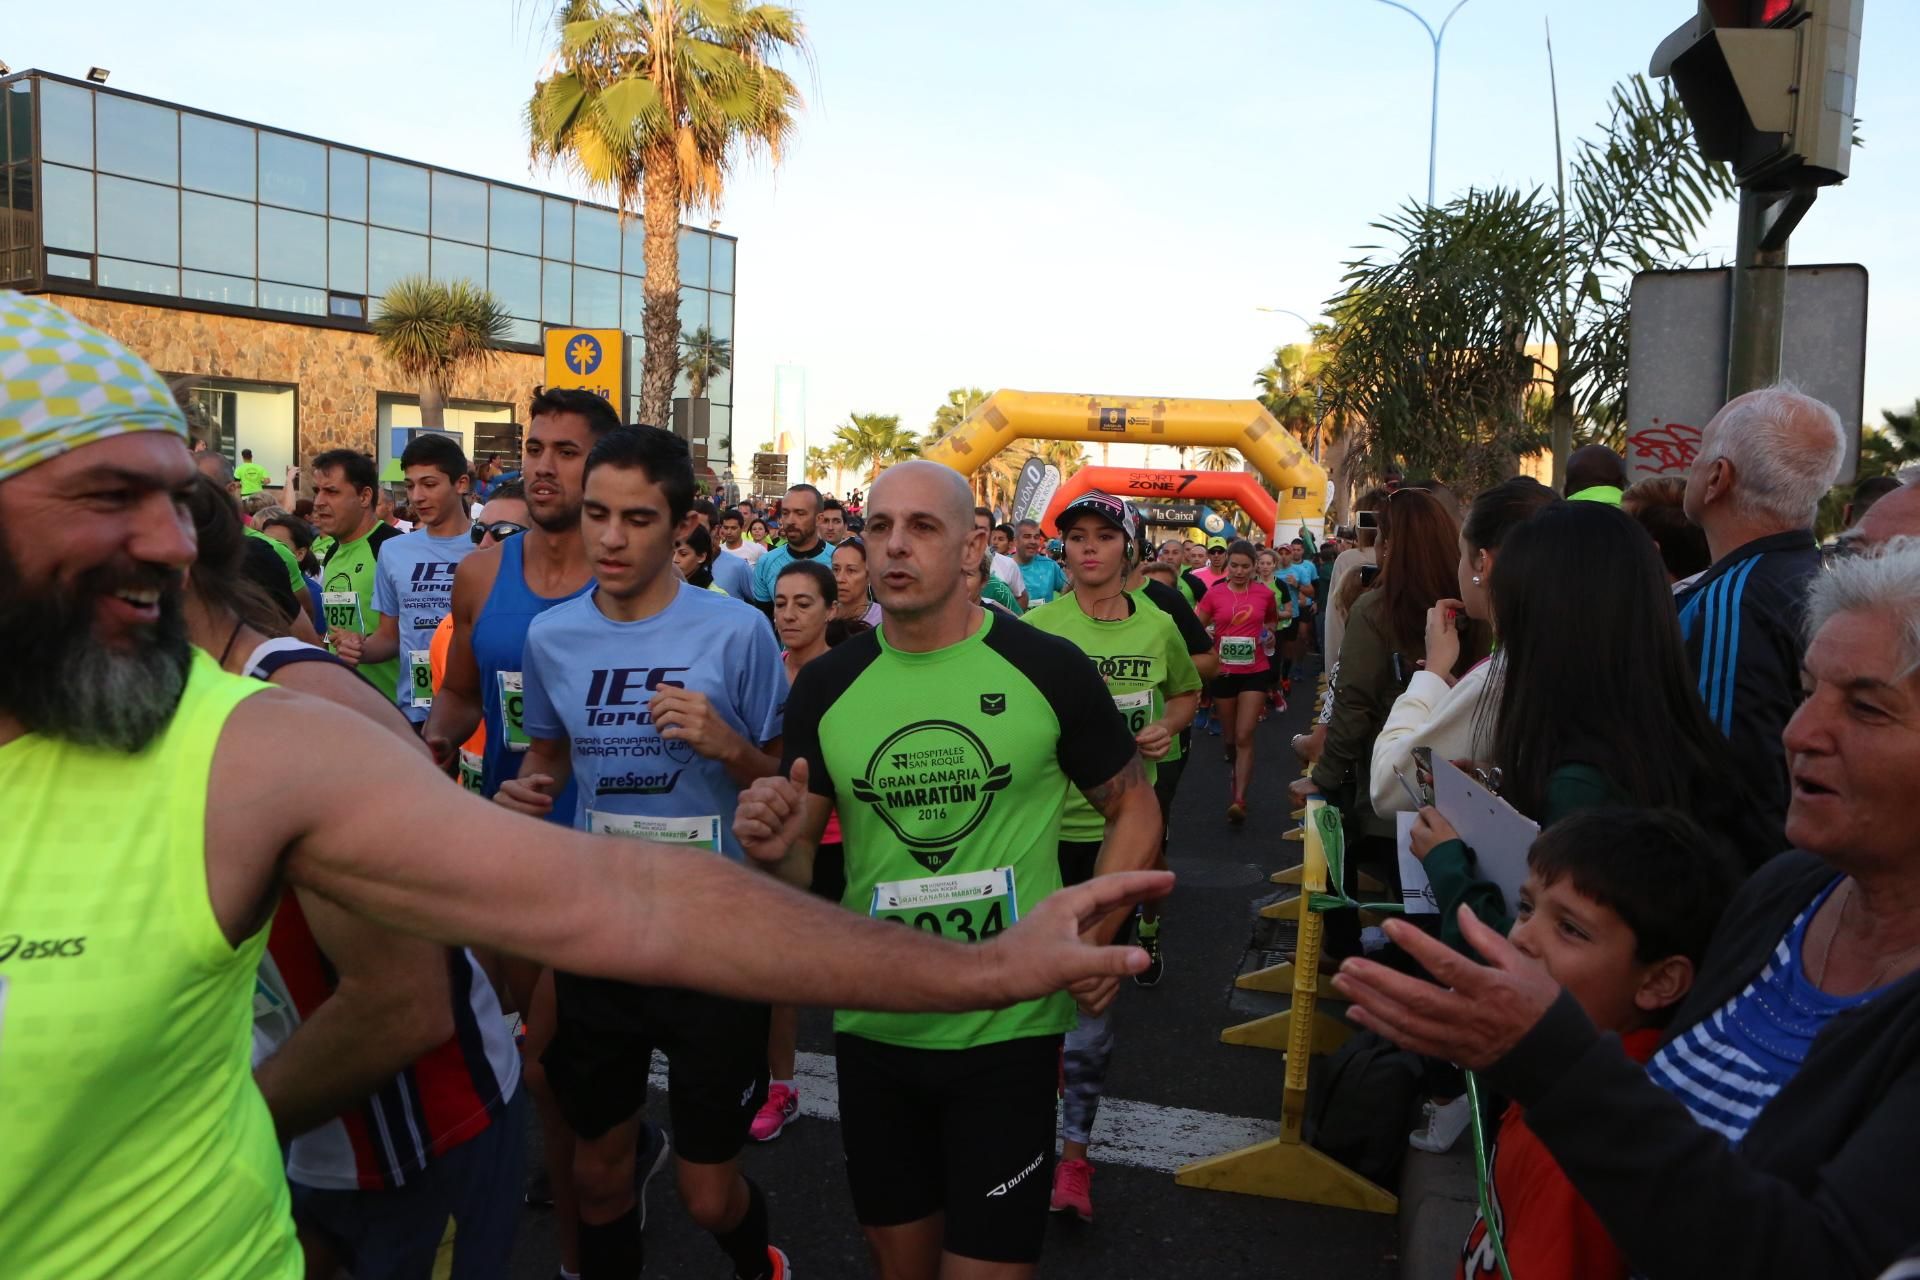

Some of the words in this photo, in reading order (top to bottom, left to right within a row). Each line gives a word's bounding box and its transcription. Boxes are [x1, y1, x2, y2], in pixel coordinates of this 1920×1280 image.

[1129, 472, 1176, 482] SPORT
[1129, 480, 1176, 491] ZONE
[1014, 481, 1034, 522] CAJÓN
[1165, 509, 1197, 521] Caixa"
[410, 582, 453, 593] Tero
[1222, 643, 1253, 657] 6822
[585, 708, 655, 727] Tero
[574, 737, 601, 746] GRAN
[602, 736, 661, 748] CANARIA
[909, 746, 965, 760] HOSPITALES
[909, 760, 928, 769] SAN
[931, 755, 965, 767] ROQUE
[598, 771, 668, 790] areSport
[878, 774, 916, 789] GRAN
[919, 768, 980, 785] CANARIA
[885, 781, 977, 809] MARATÓN
[918, 808, 947, 821] 2016
[919, 892, 951, 903] CANARIA
[950, 886, 983, 898] MARATÓN
[884, 901, 1006, 944] 034
[19, 936, 87, 960] asics
[1007, 1151, 1045, 1190] OUTPACE
